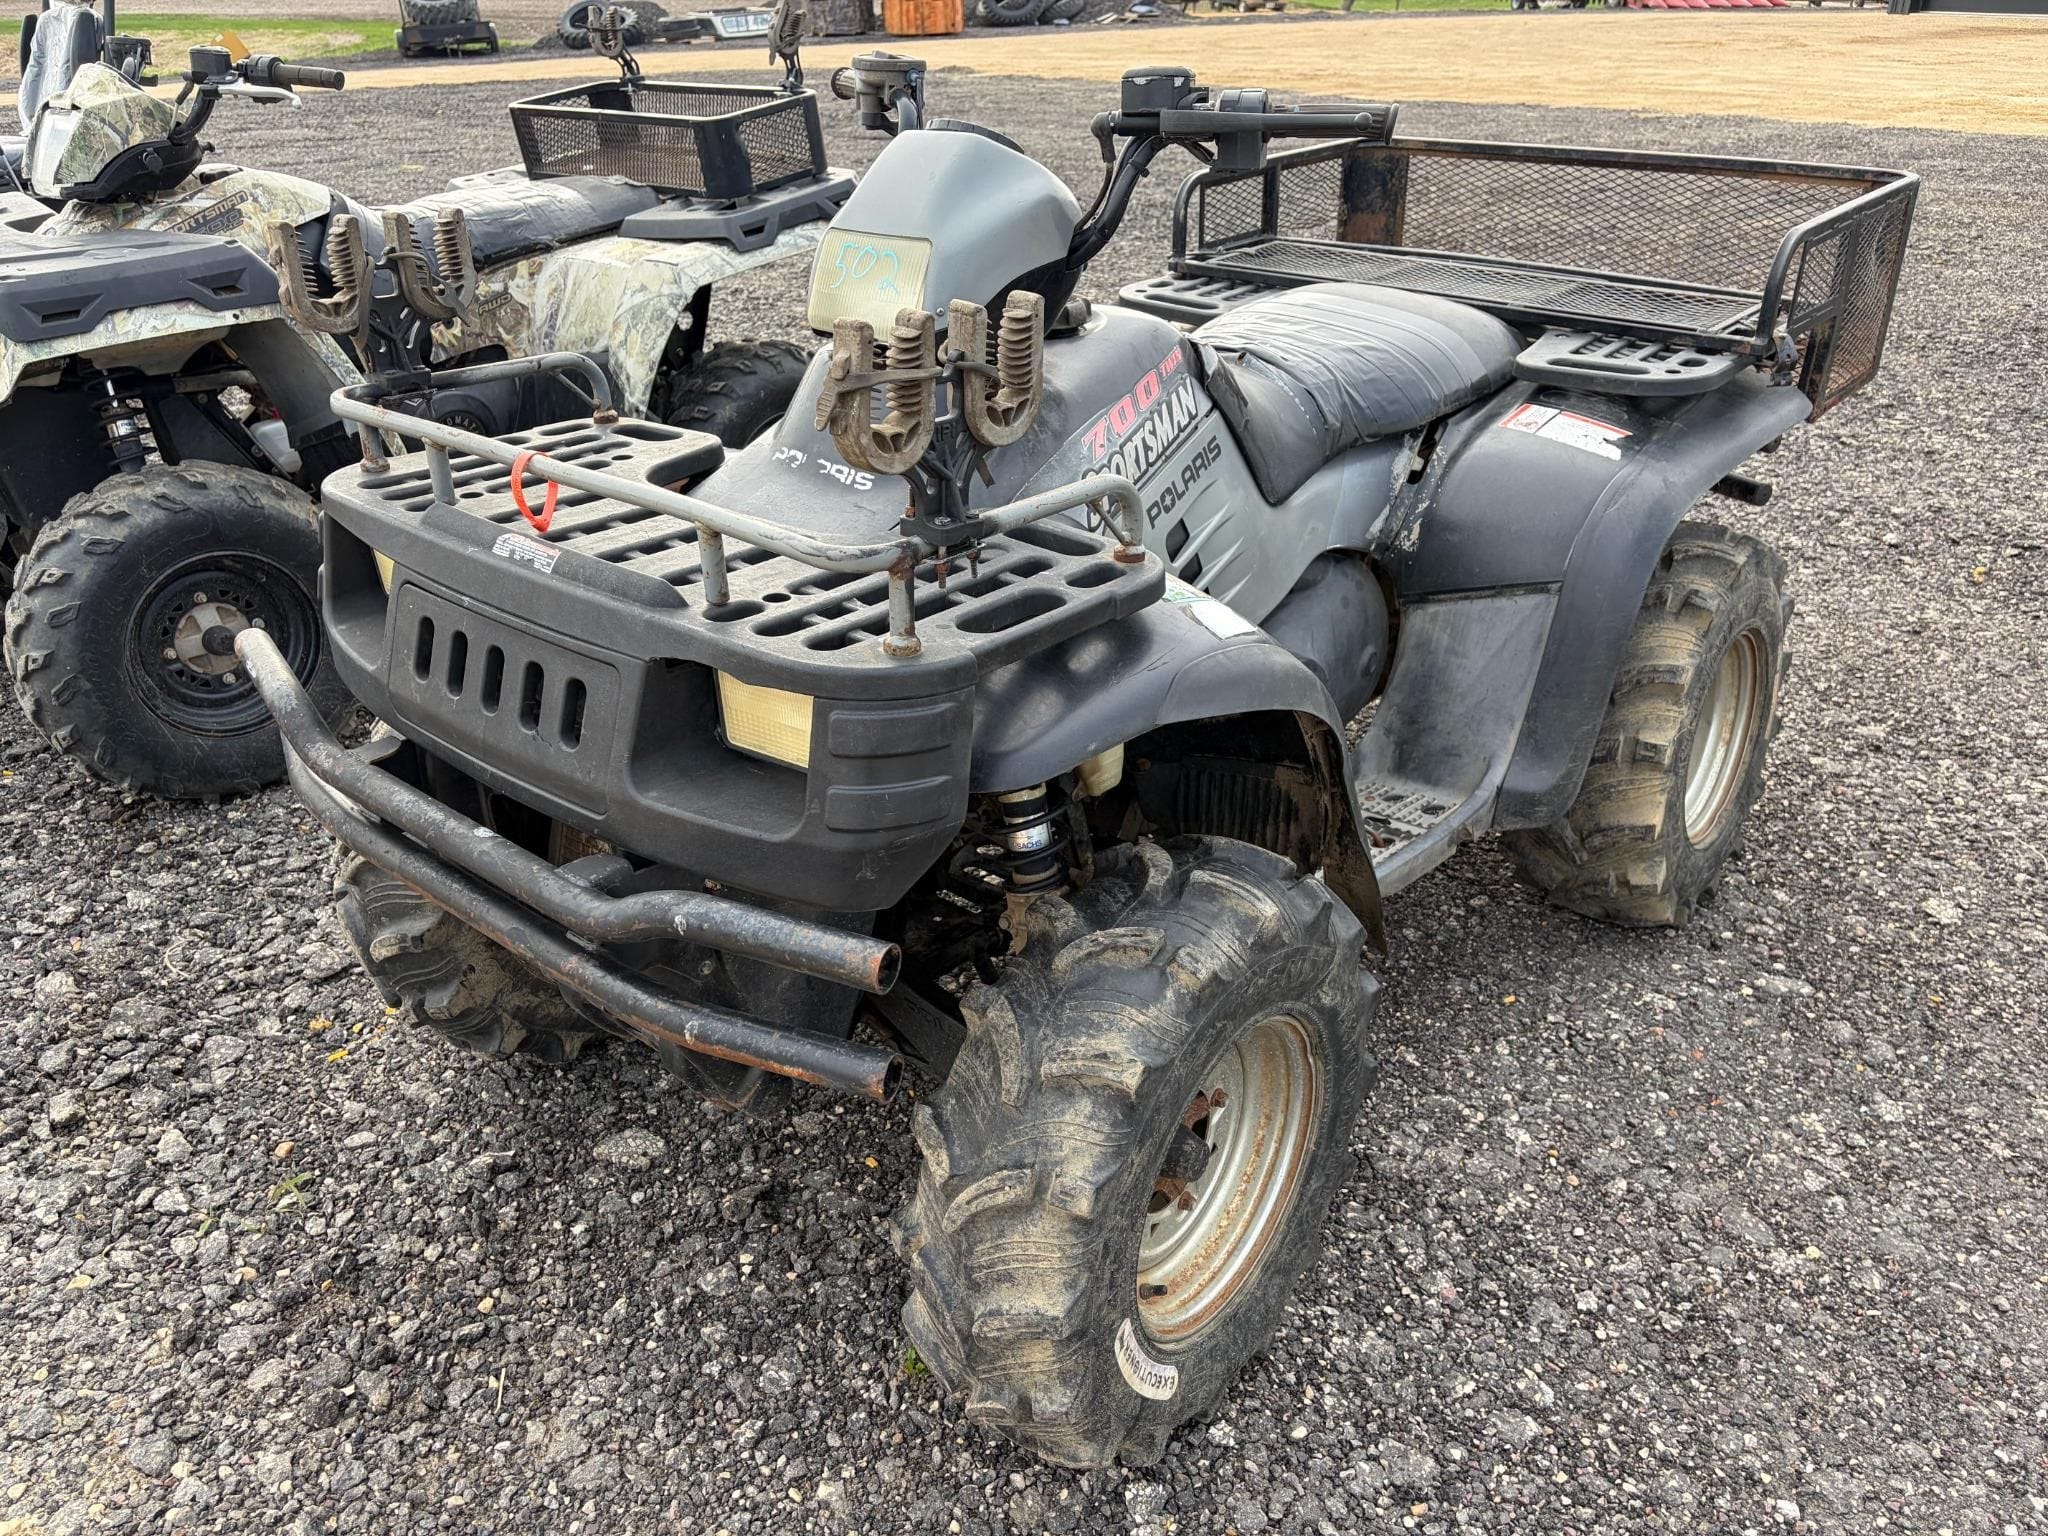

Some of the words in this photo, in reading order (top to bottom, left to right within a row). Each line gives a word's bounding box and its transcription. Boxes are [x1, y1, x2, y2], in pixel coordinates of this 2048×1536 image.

[168, 190, 247, 234] ORTSMAN
[831, 242, 899, 293] 502
[478, 293, 512, 315] AWD
[1082, 369, 1161, 463] 700
[772, 447, 875, 490] POARIS
[1087, 377, 1199, 531] ORTSMAN
[1146, 435, 1222, 530] POLARIS
[1016, 839, 1042, 850] SACHS
[1123, 1340, 1176, 1390] EXECUTIONER
